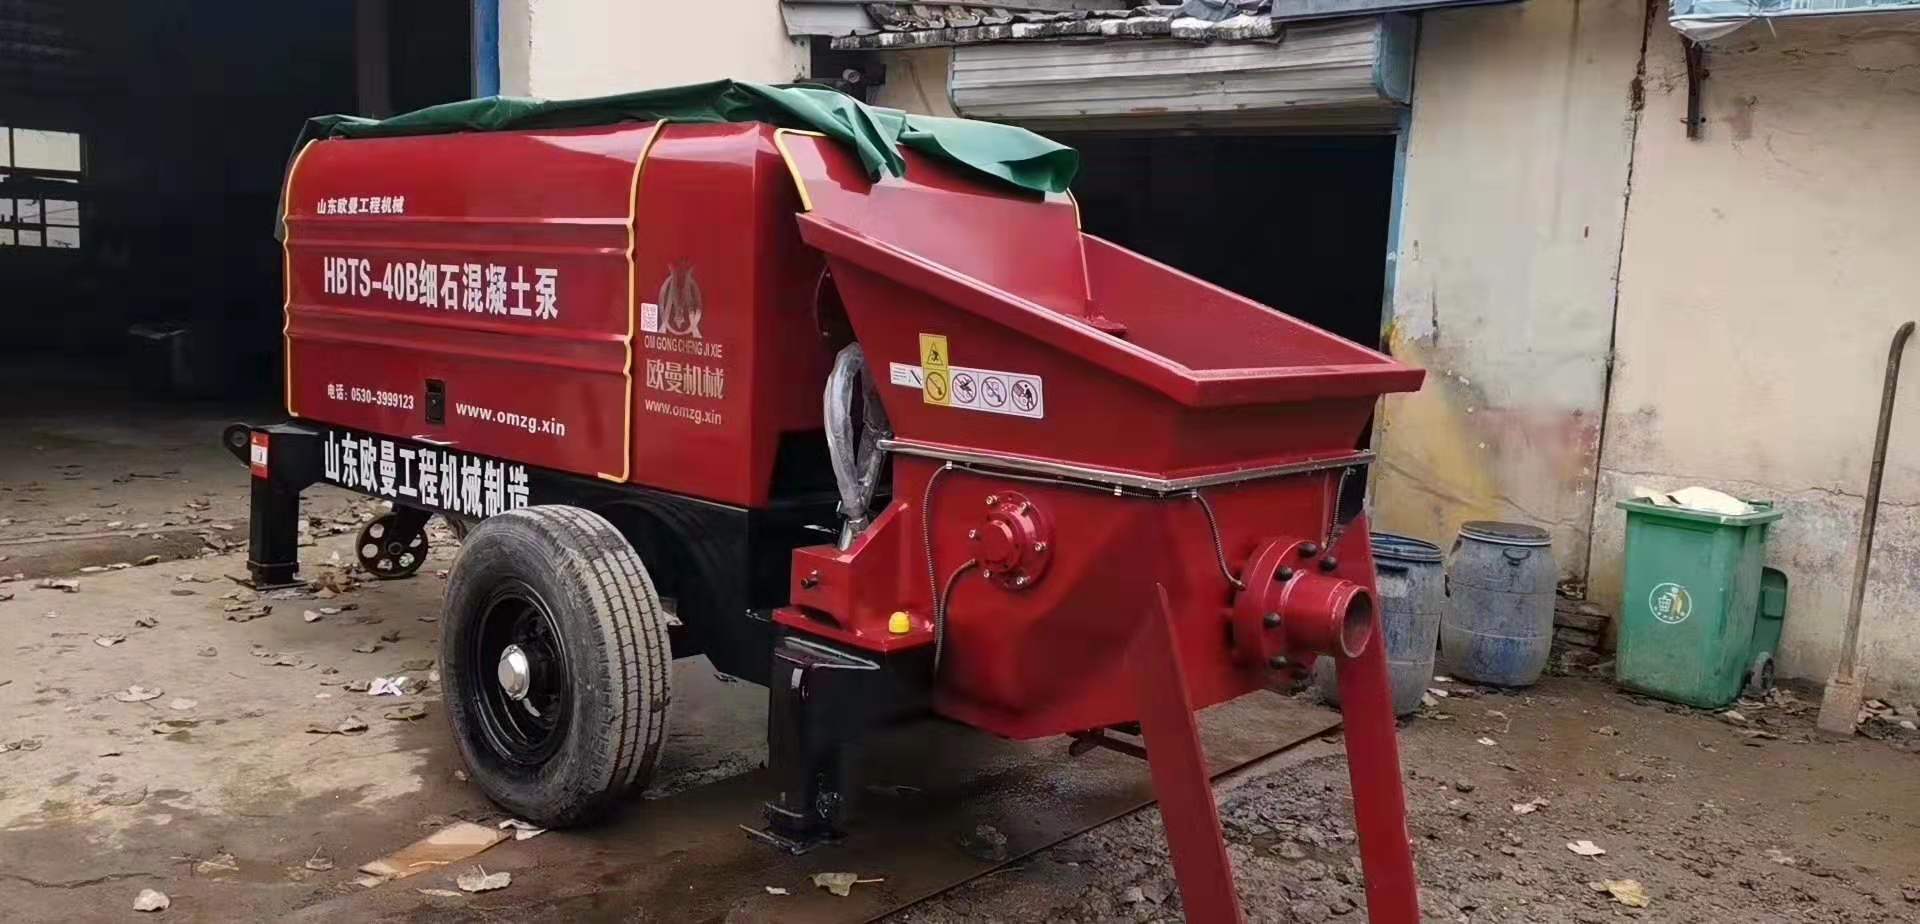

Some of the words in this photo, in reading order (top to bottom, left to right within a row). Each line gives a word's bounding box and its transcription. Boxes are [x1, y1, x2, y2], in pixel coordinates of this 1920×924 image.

[316, 196, 405, 214] 山东欧曼工程机械
[324, 256, 559, 320] HBTS-40B细石混凝土泵
[646, 359, 725, 400] 欧曼机械
[351, 387, 414, 410] 0530-3999123
[644, 400, 722, 425] www.omzg.xin
[456, 402, 566, 437] www.omzg.xin
[324, 430, 530, 518] 山东欧曼工程机械制造
